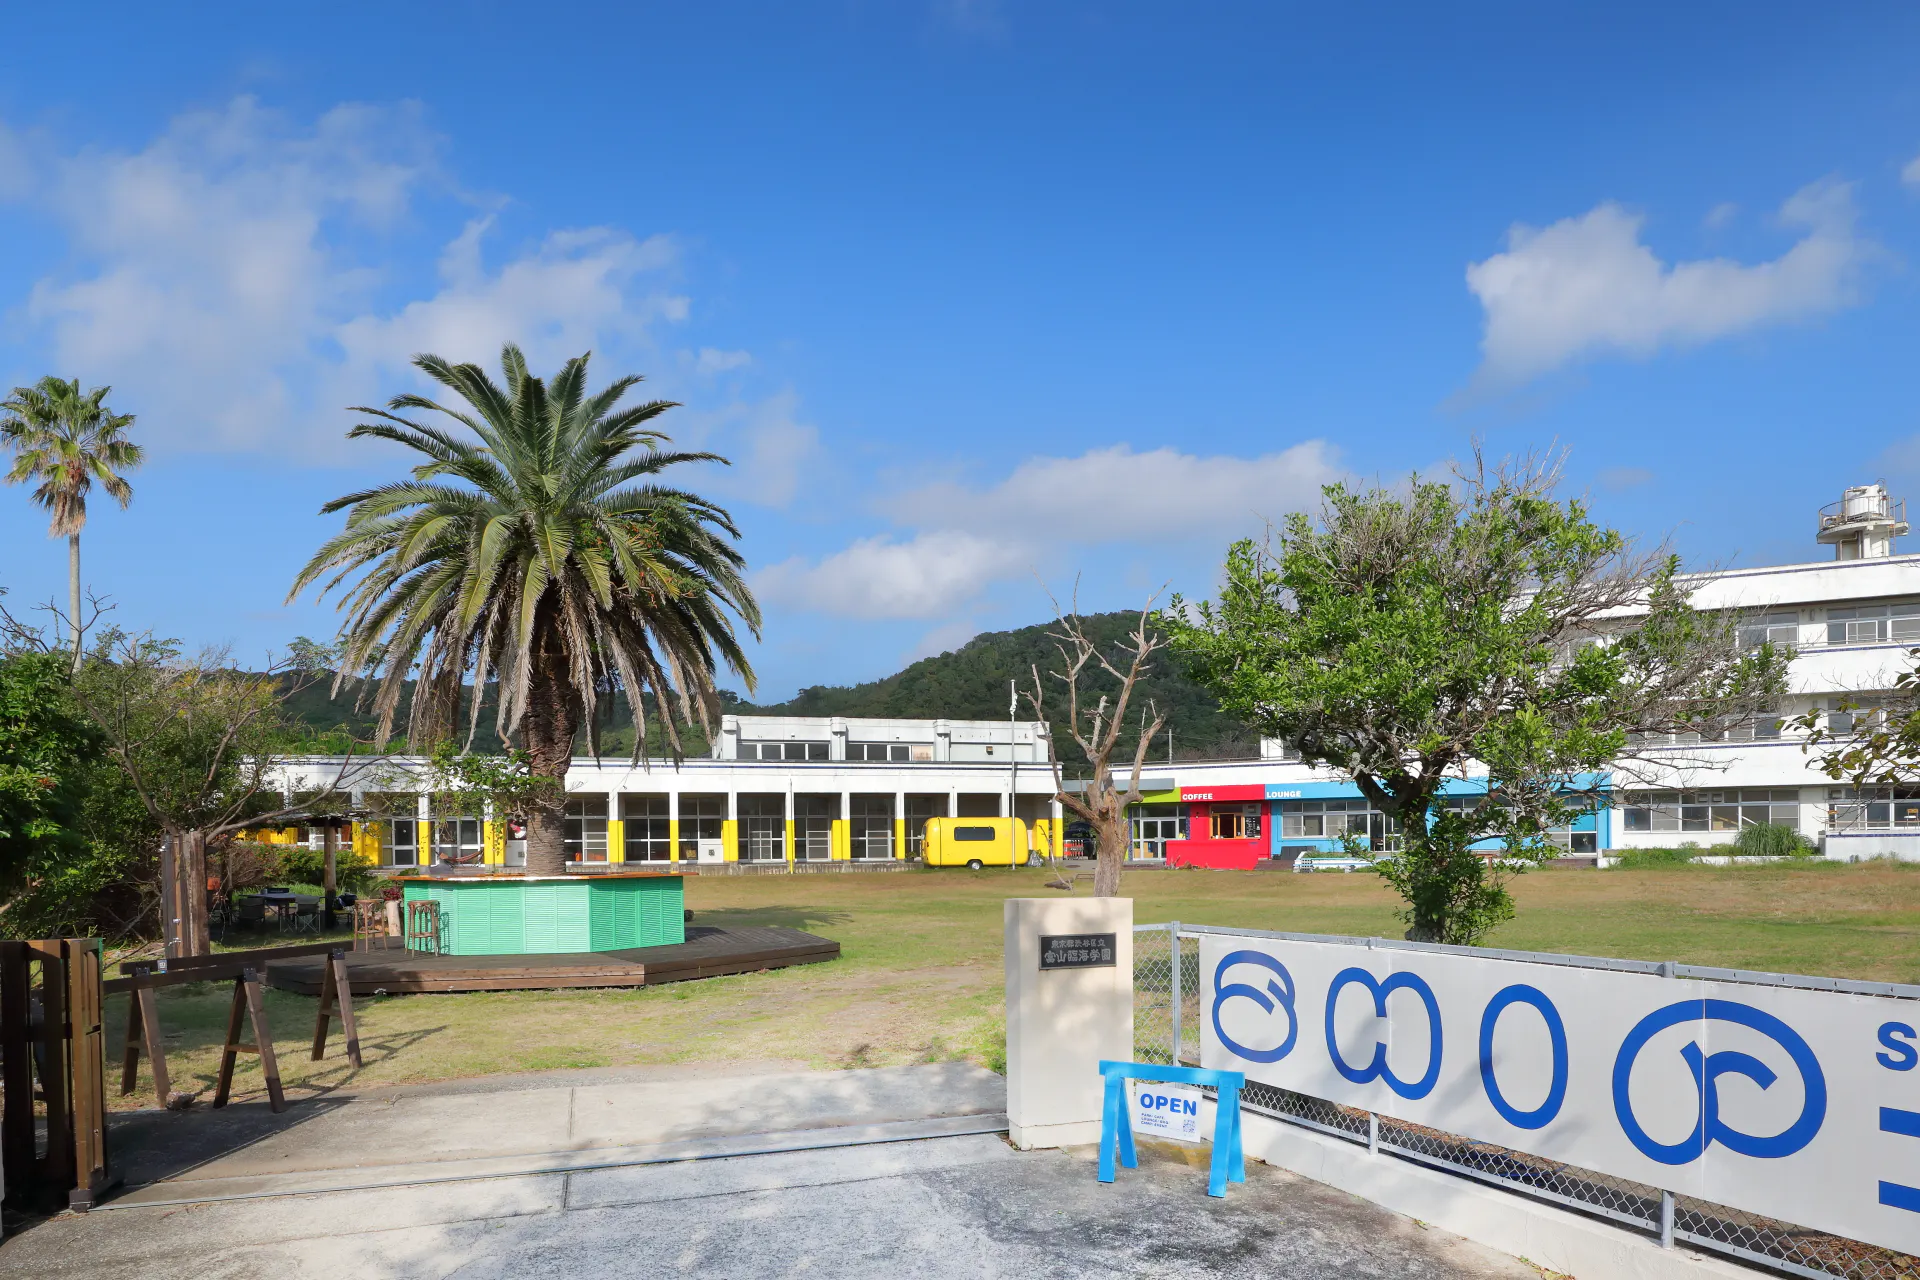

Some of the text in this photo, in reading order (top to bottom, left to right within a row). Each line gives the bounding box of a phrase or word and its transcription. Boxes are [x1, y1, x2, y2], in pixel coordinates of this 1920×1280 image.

[1266, 790, 1301, 798] LOUNGE
[1044, 948, 1112, 964] 富山臨海学園
[1140, 1093, 1197, 1116] OPEN
